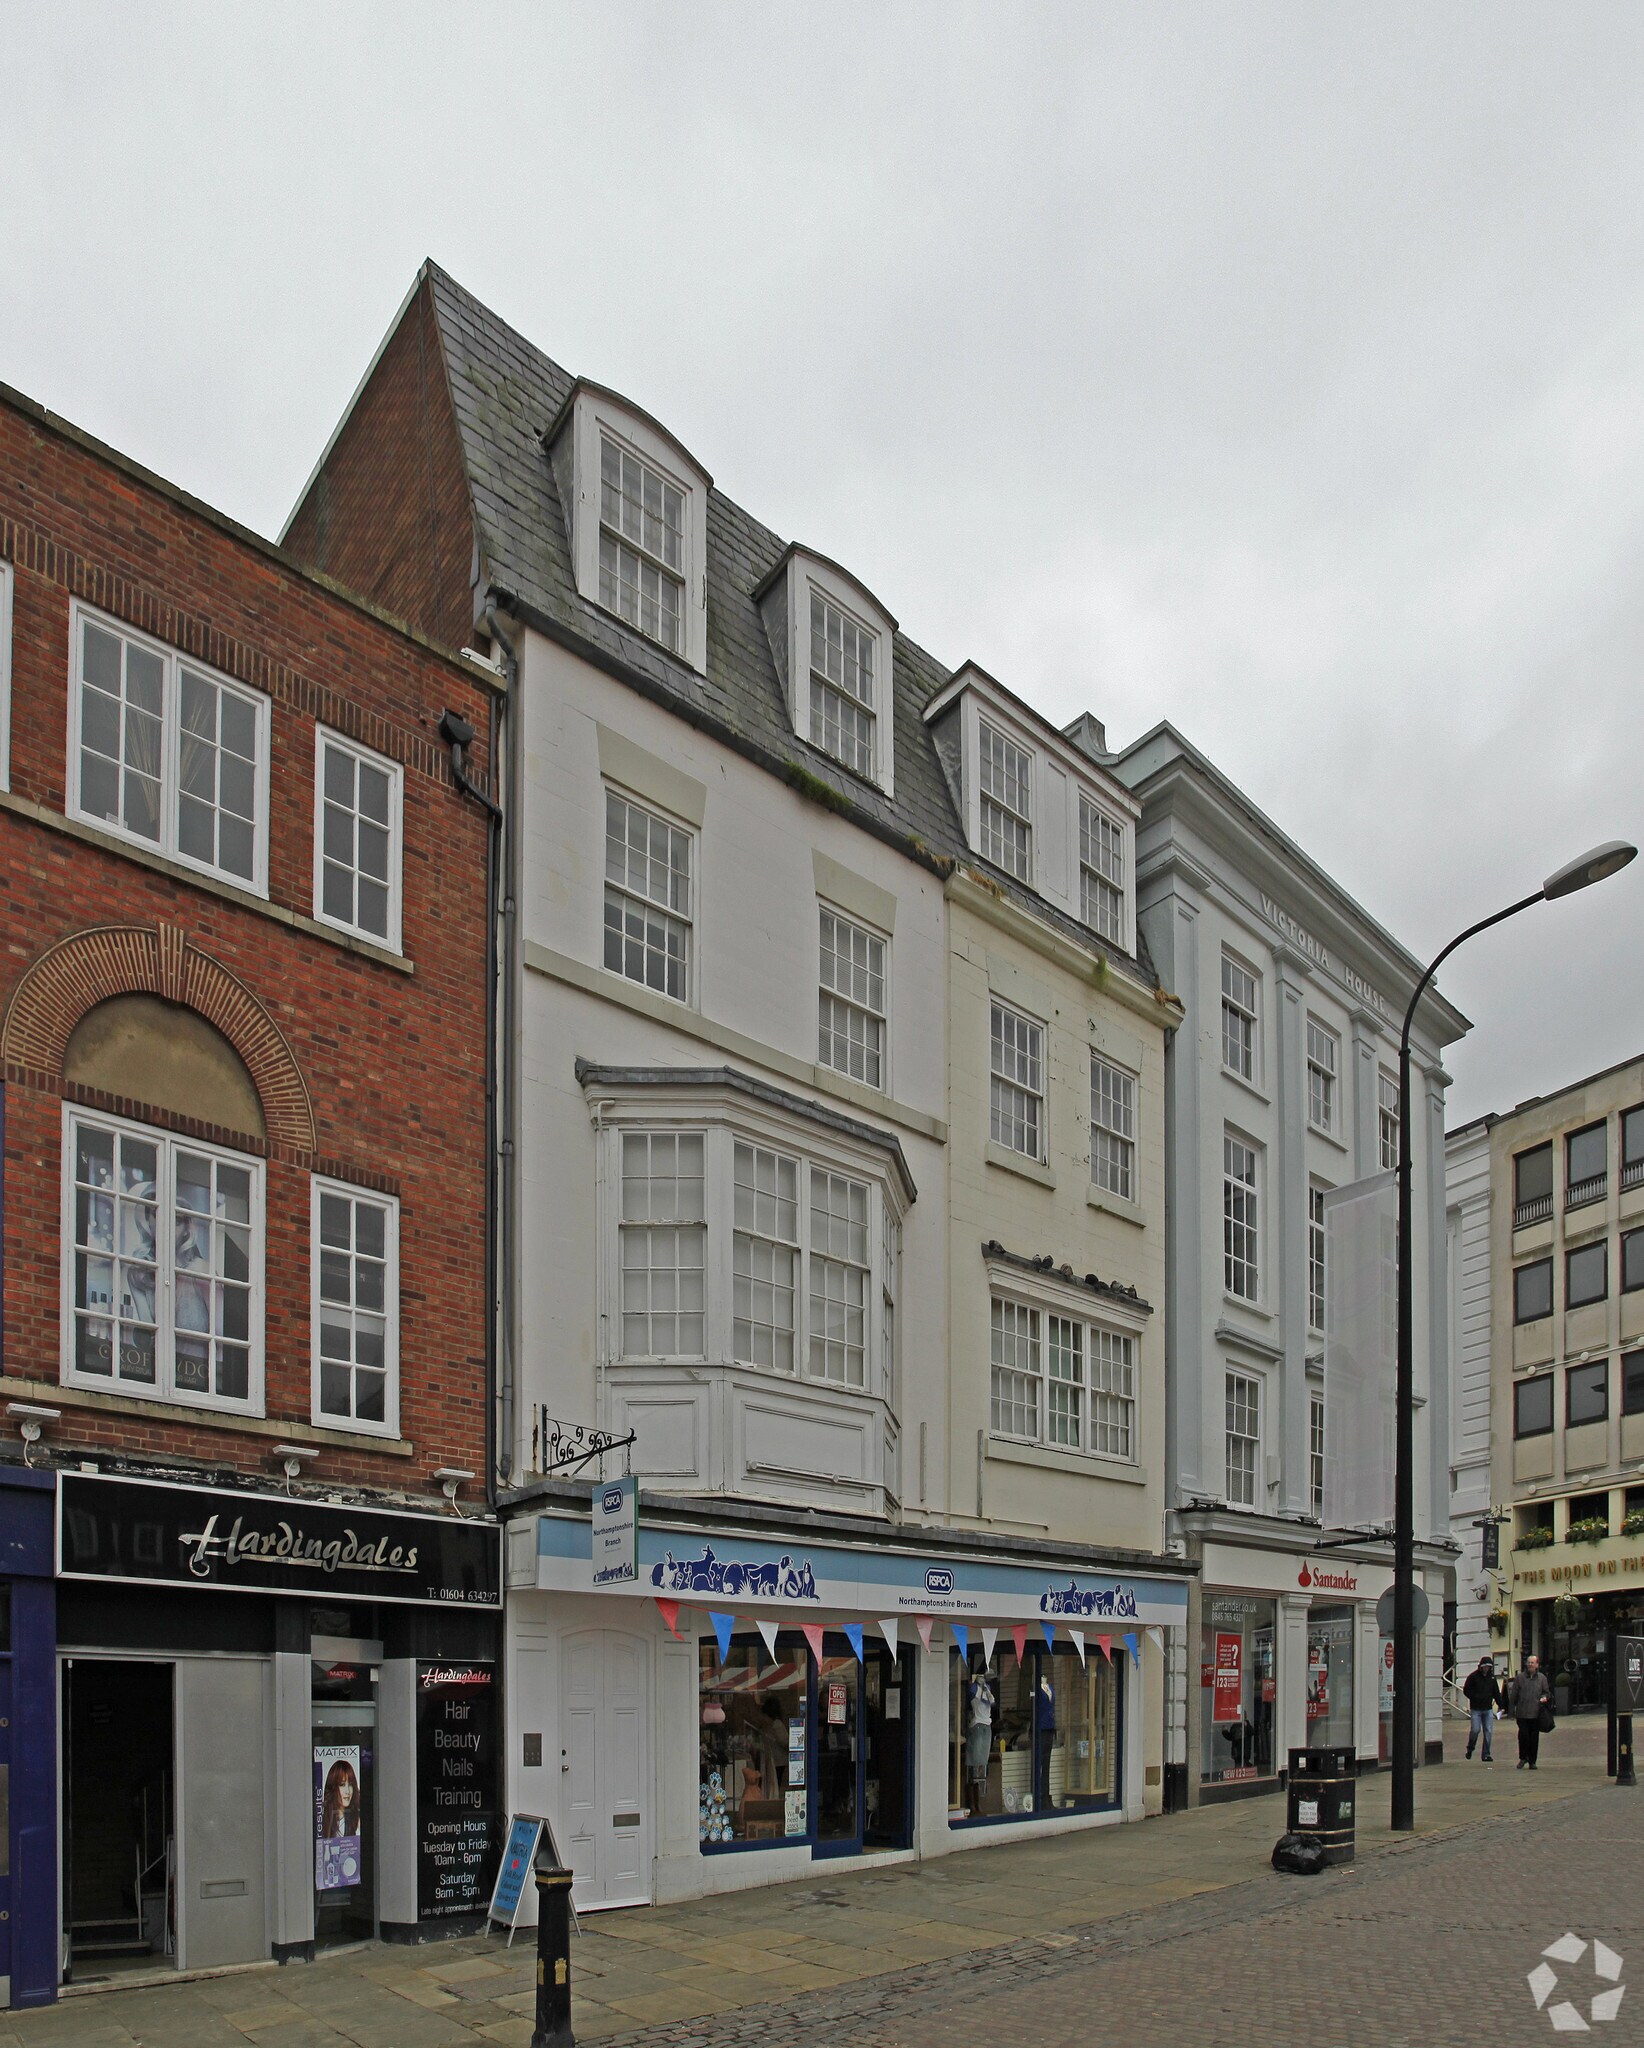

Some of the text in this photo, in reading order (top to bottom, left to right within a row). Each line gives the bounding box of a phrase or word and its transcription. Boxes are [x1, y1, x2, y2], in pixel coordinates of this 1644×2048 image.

[1261, 892, 1329, 968] VICTORIA
[604, 1494, 621, 1507] RSPCA
[593, 1521, 634, 1537] Northamptonshire
[178, 1514, 418, 1577] Hardingdales
[605, 1537, 622, 1547] Branch
[1313, 1567, 1357, 1590] Santander
[1521, 1569, 1545, 1585] THE
[1551, 1562, 1591, 1581] MOON
[1598, 1559, 1617, 1575] ON
[928, 1574, 951, 1587] RSPCA
[427, 1586, 498, 1603] T: 01604 634297
[898, 1596, 978, 1609] Northamptonshire Branch
[1212, 1601, 1257, 1613] santander.co.uk
[421, 1668, 491, 1687] Hardingdales
[1216, 1677, 1228, 1687] 123
[832, 1689, 845, 1699] OPEN
[445, 1701, 471, 1719] Hair
[434, 1729, 481, 1752] Beauty
[315, 1747, 359, 1757] MATRIX
[442, 1758, 473, 1777] Nails
[433, 1786, 482, 1808] Training
[316, 1788, 324, 1839] results
[427, 1820, 486, 1836] Opening Hours
[422, 1838, 492, 1854] Tuesday to Friday
[434, 1854, 455, 1866] 10am
[463, 1853, 482, 1865] 6pm
[439, 1872, 476, 1886] Saturday
[435, 1887, 454, 1899] 9am
[461, 1885, 480, 1898] 5pm
[421, 1907, 431, 1915] Late
[432, 1905, 444, 1915] night
[444, 1902, 474, 1914] appointments
